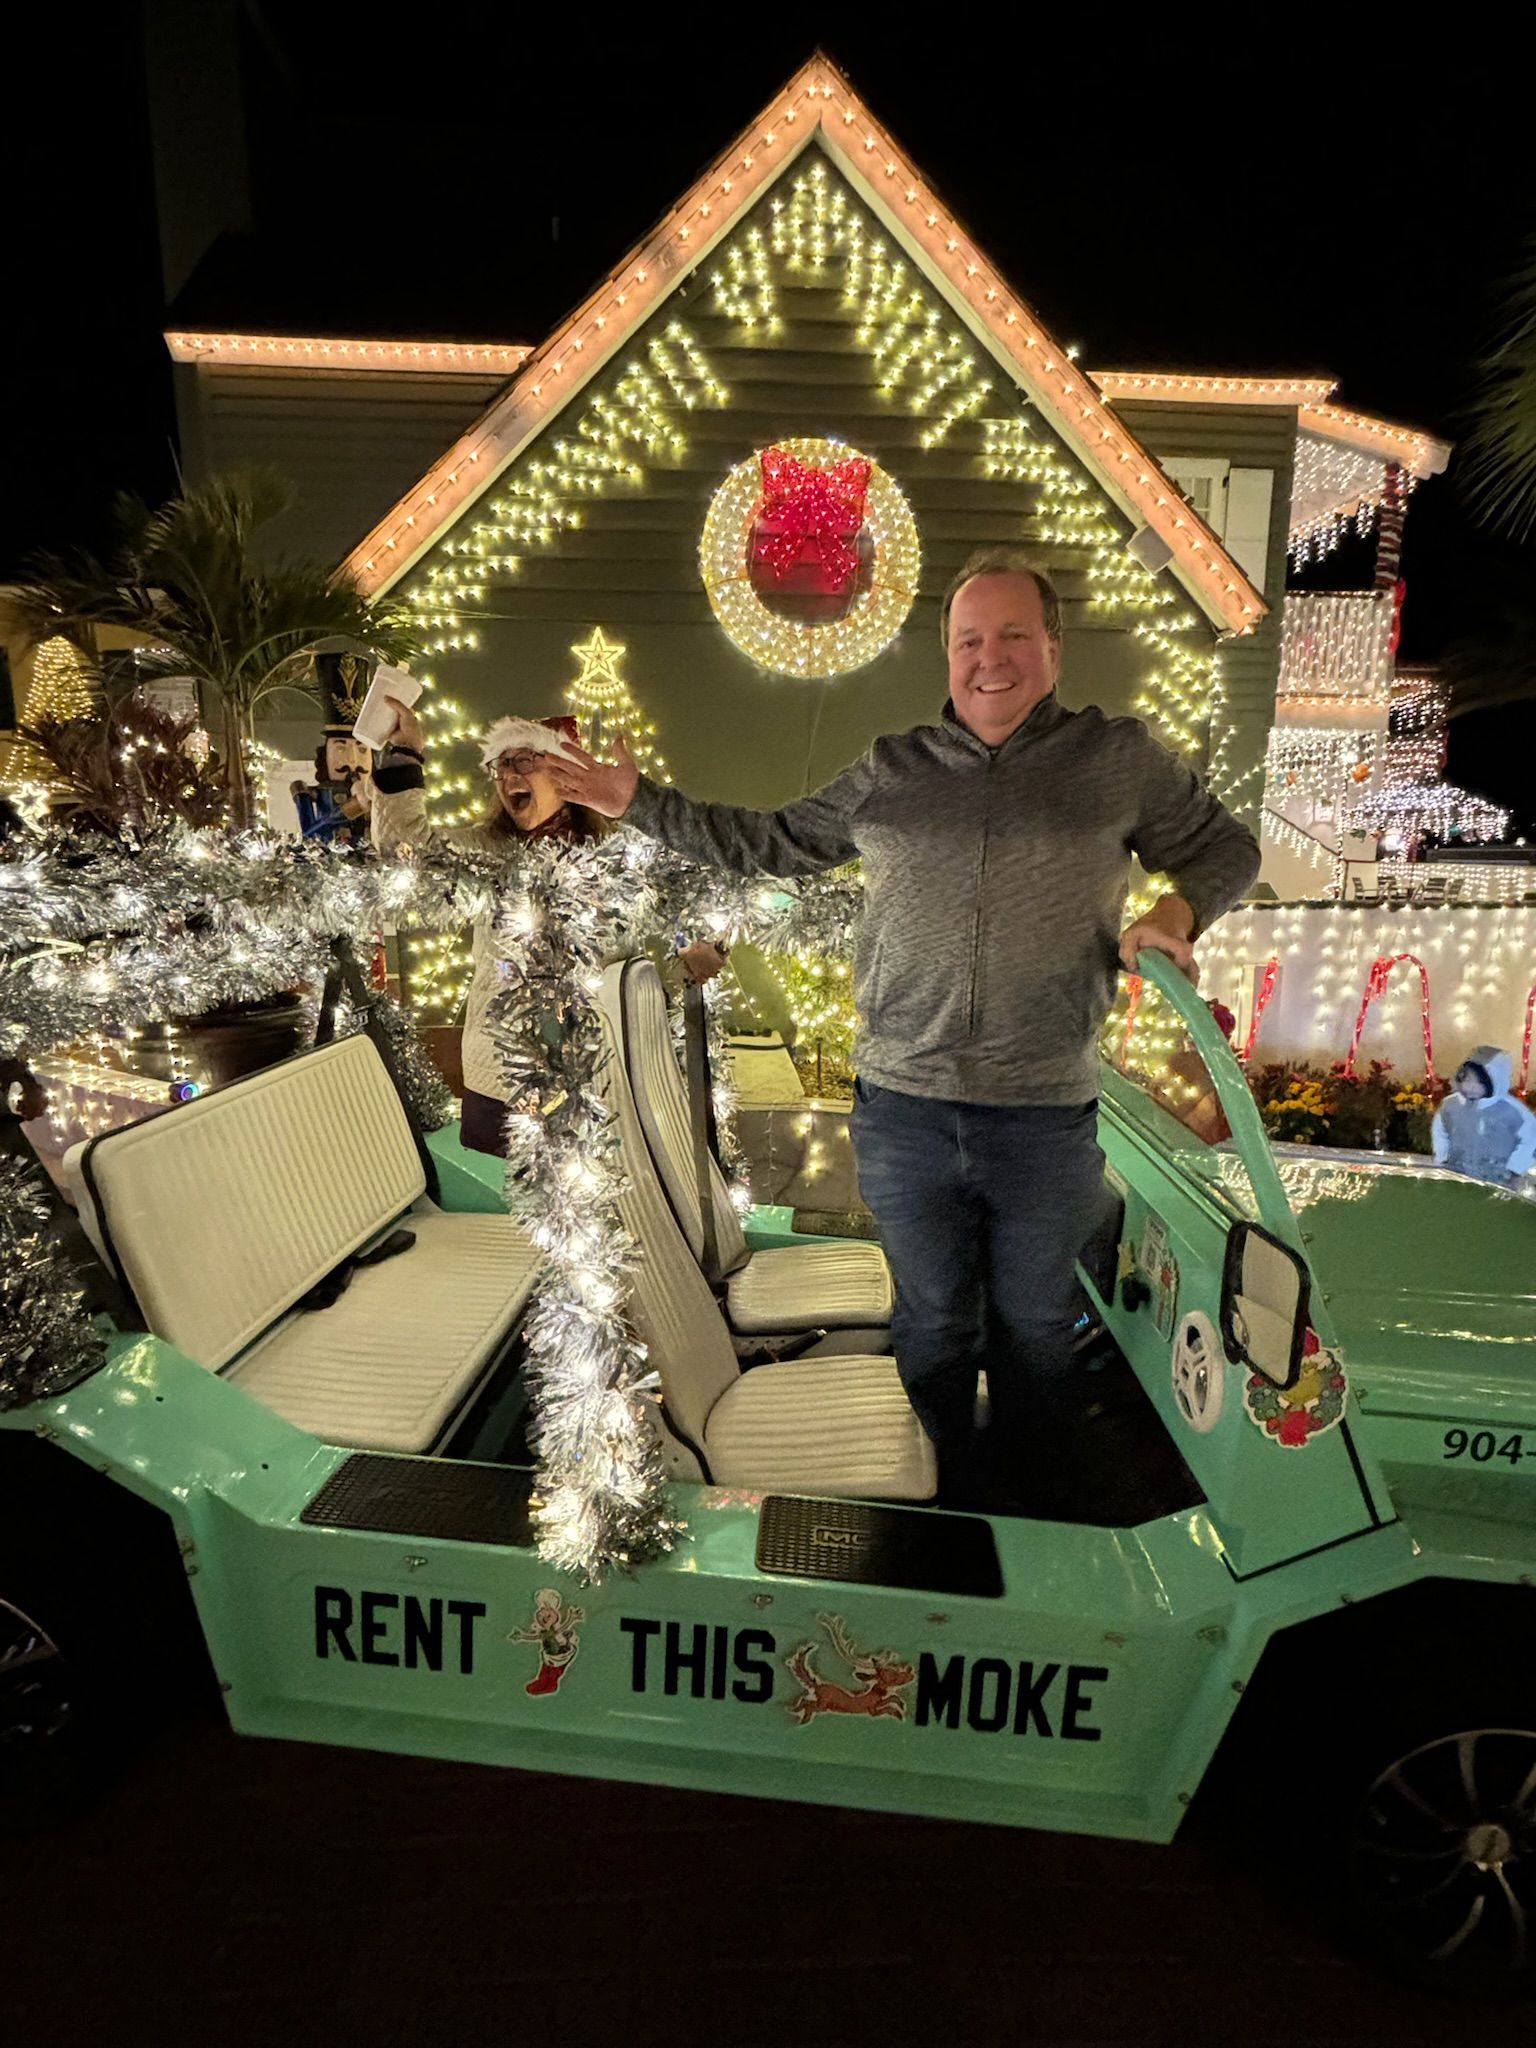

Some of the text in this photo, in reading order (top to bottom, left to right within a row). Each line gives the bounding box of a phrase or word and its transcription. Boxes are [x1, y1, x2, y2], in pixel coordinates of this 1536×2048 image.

[314, 1585, 1109, 1742] RENT THIS MOKE
